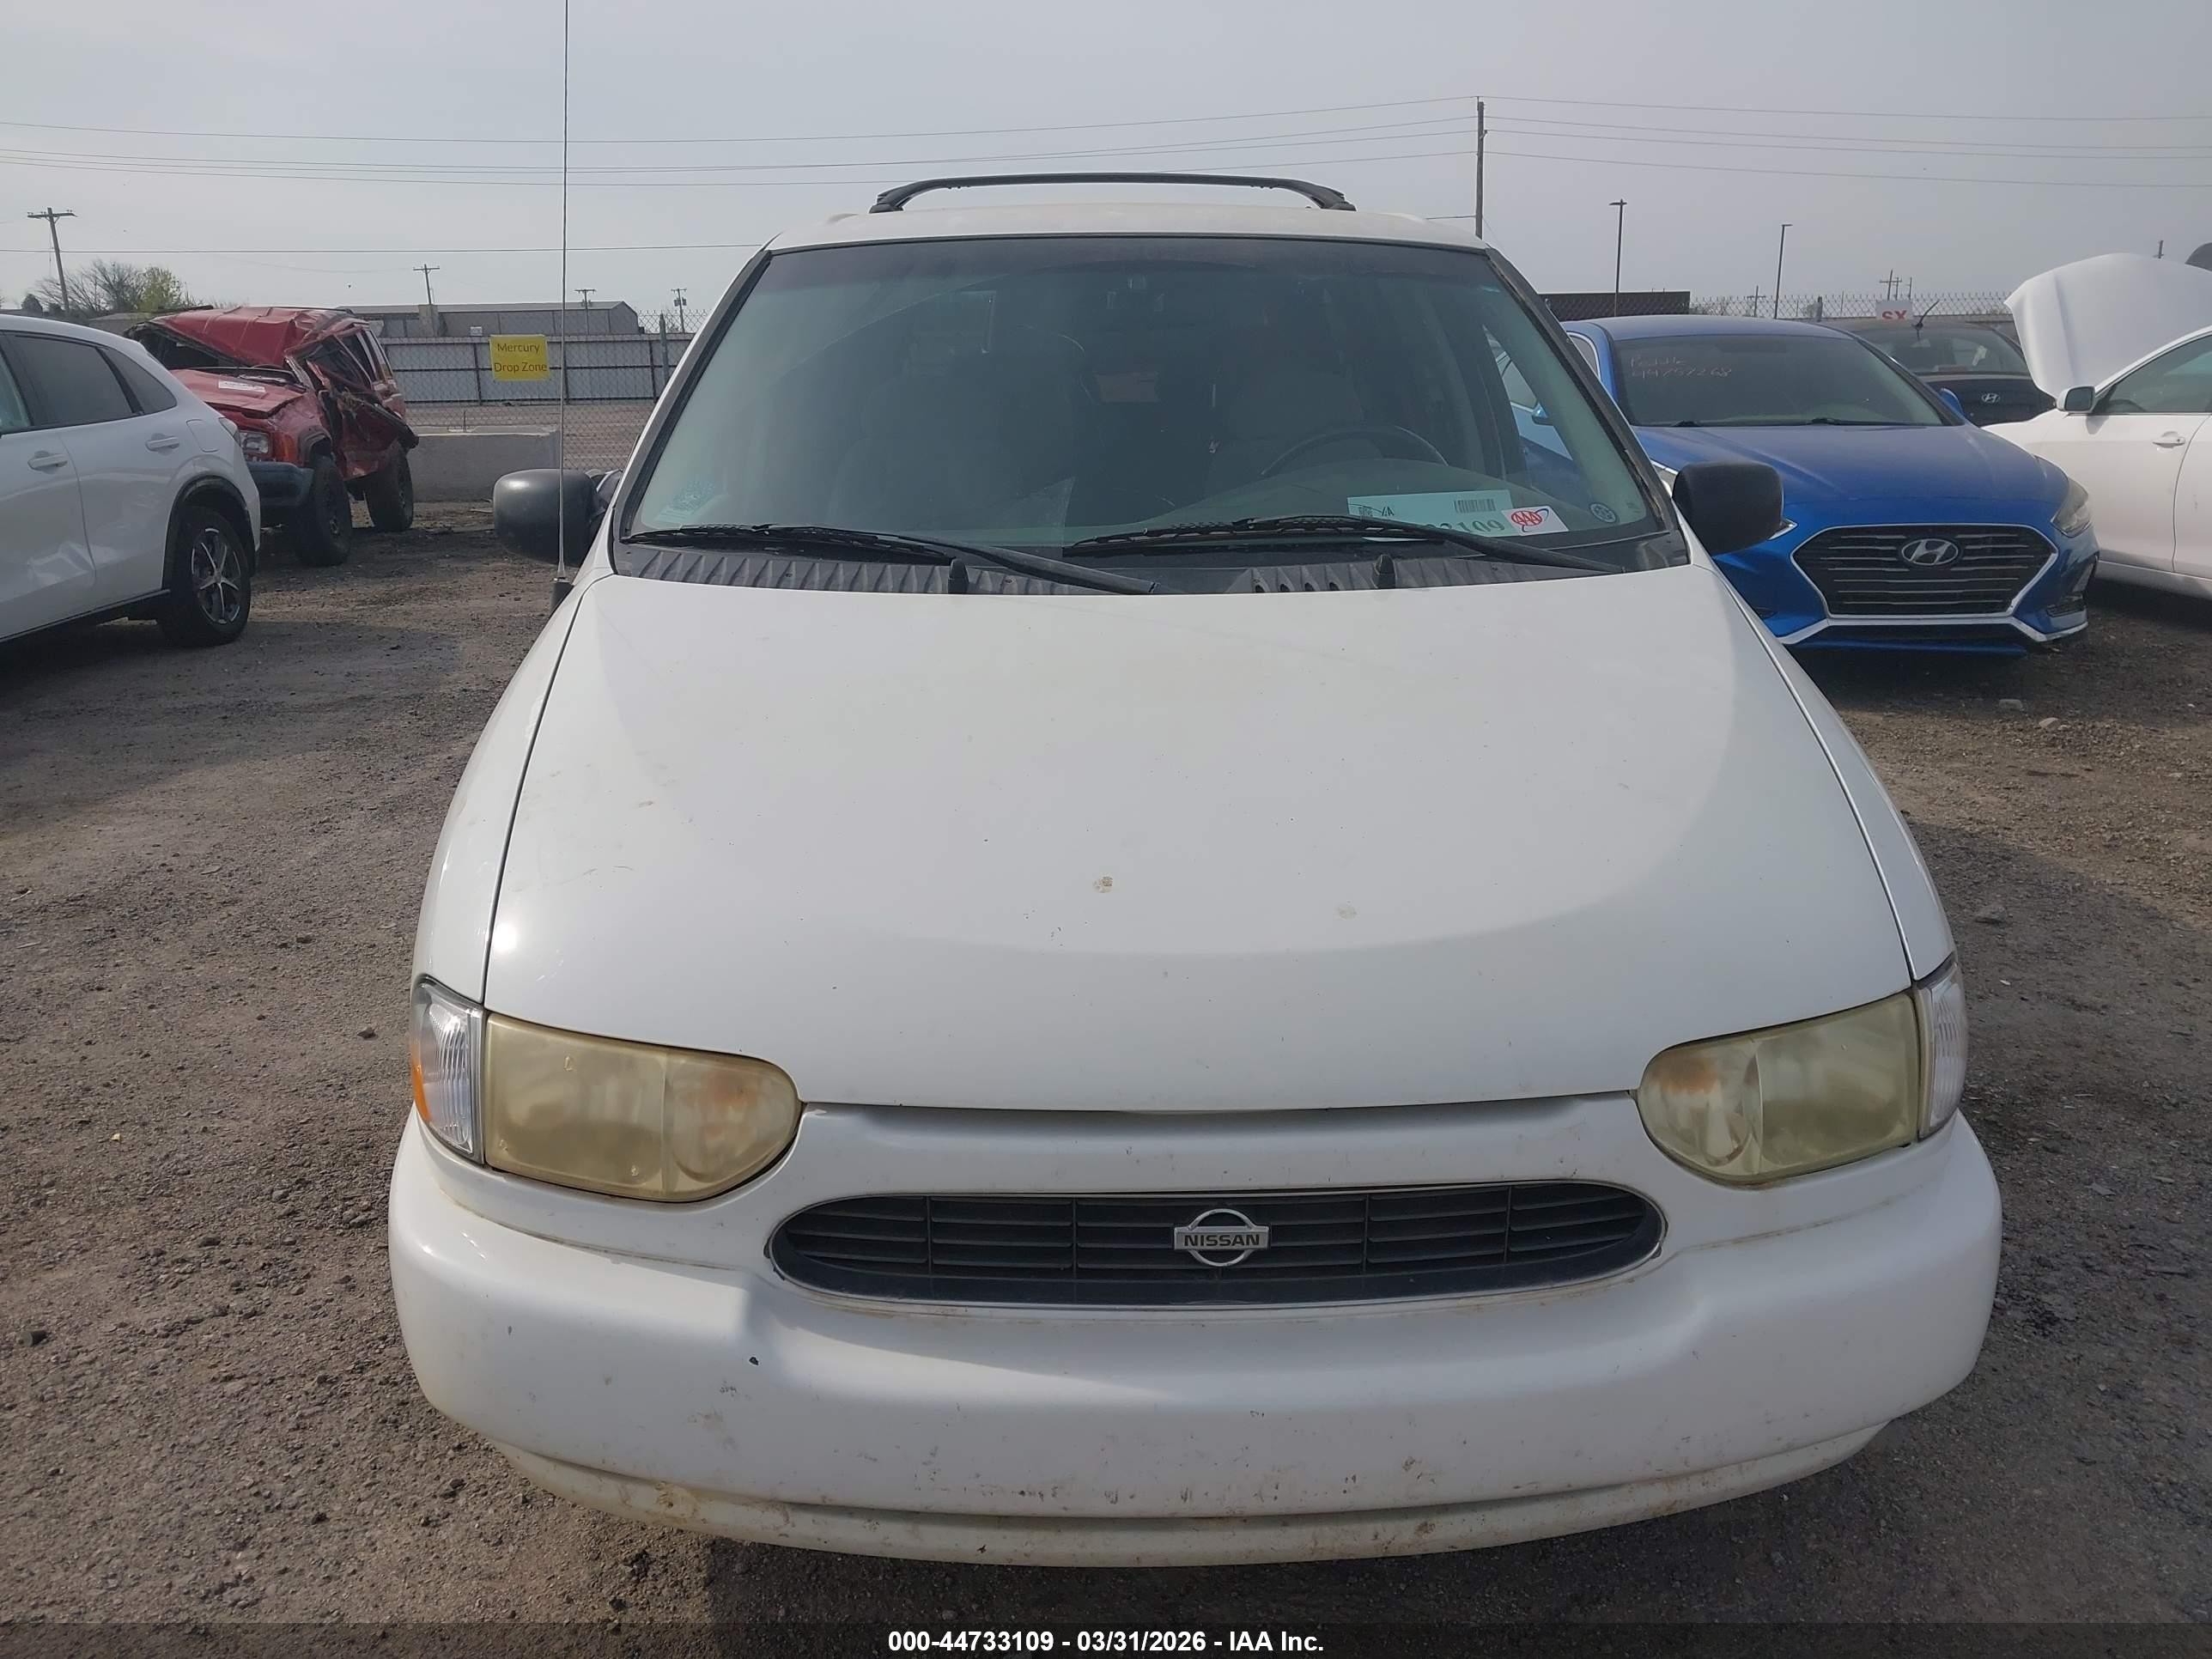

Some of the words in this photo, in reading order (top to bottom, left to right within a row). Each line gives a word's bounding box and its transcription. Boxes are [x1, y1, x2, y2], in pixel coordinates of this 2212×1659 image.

[497, 343, 539, 353] Mercury
[494, 362, 519, 373] Drop
[521, 362, 547, 372] Zone
[1515, 511, 1540, 526] AAA
[1184, 1234, 1260, 1247] NISSAN
